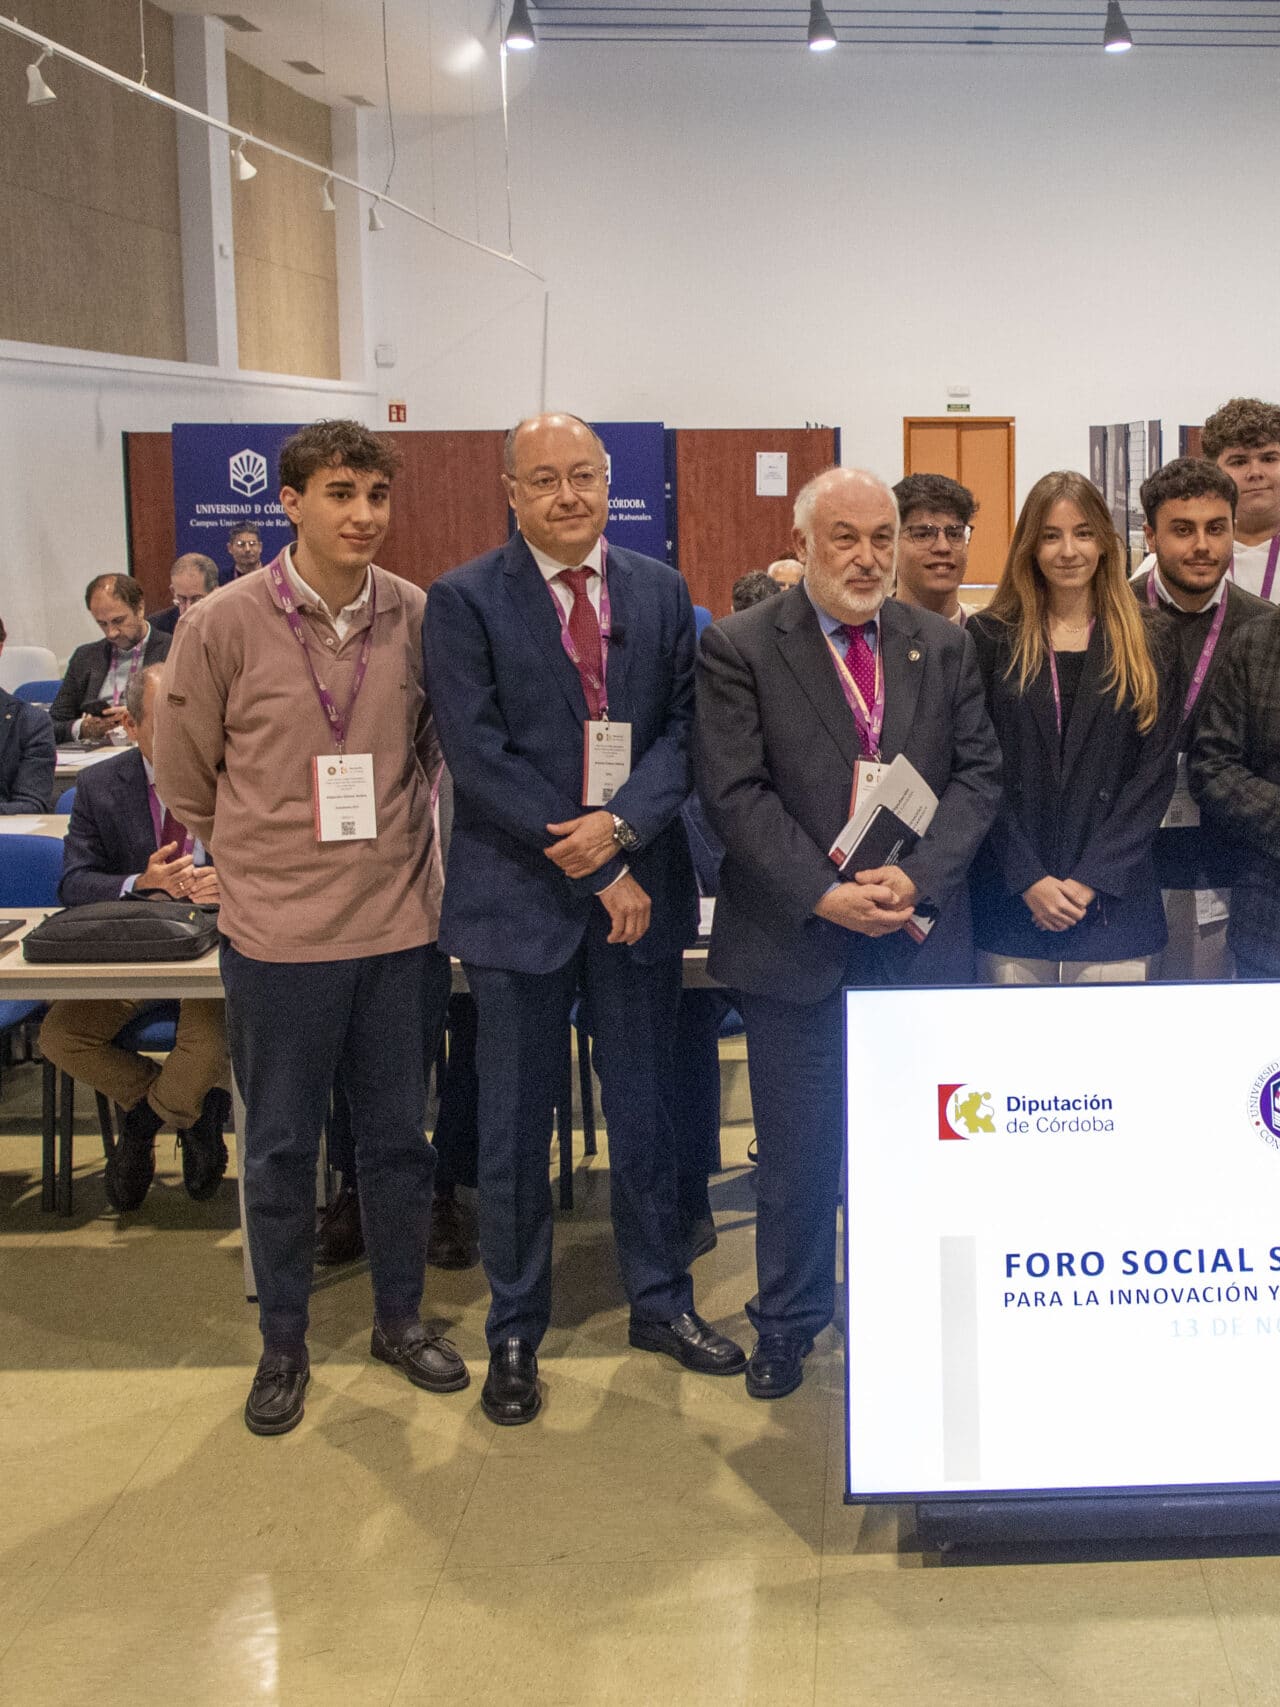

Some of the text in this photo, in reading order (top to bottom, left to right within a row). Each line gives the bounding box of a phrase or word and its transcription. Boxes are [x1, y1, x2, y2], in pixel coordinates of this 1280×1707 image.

[195, 503, 251, 515] UNIVERSIDAD
[608, 497, 646, 508] CÓRDOBA
[189, 519, 218, 528] Campus
[1006, 1094, 1113, 1116] Diputación
[1006, 1116, 1115, 1134] de Córdoba
[1005, 1251, 1105, 1278] FORO
[1122, 1247, 1254, 1276] SOCIAL
[1004, 1291, 1062, 1308] PARA
[1073, 1290, 1100, 1306] LA
[1110, 1282, 1258, 1305] INNOVACIÓN
[1268, 1285, 1280, 1301] Y
[1170, 1318, 1200, 1338] 13
[1212, 1317, 1240, 1337] DE
